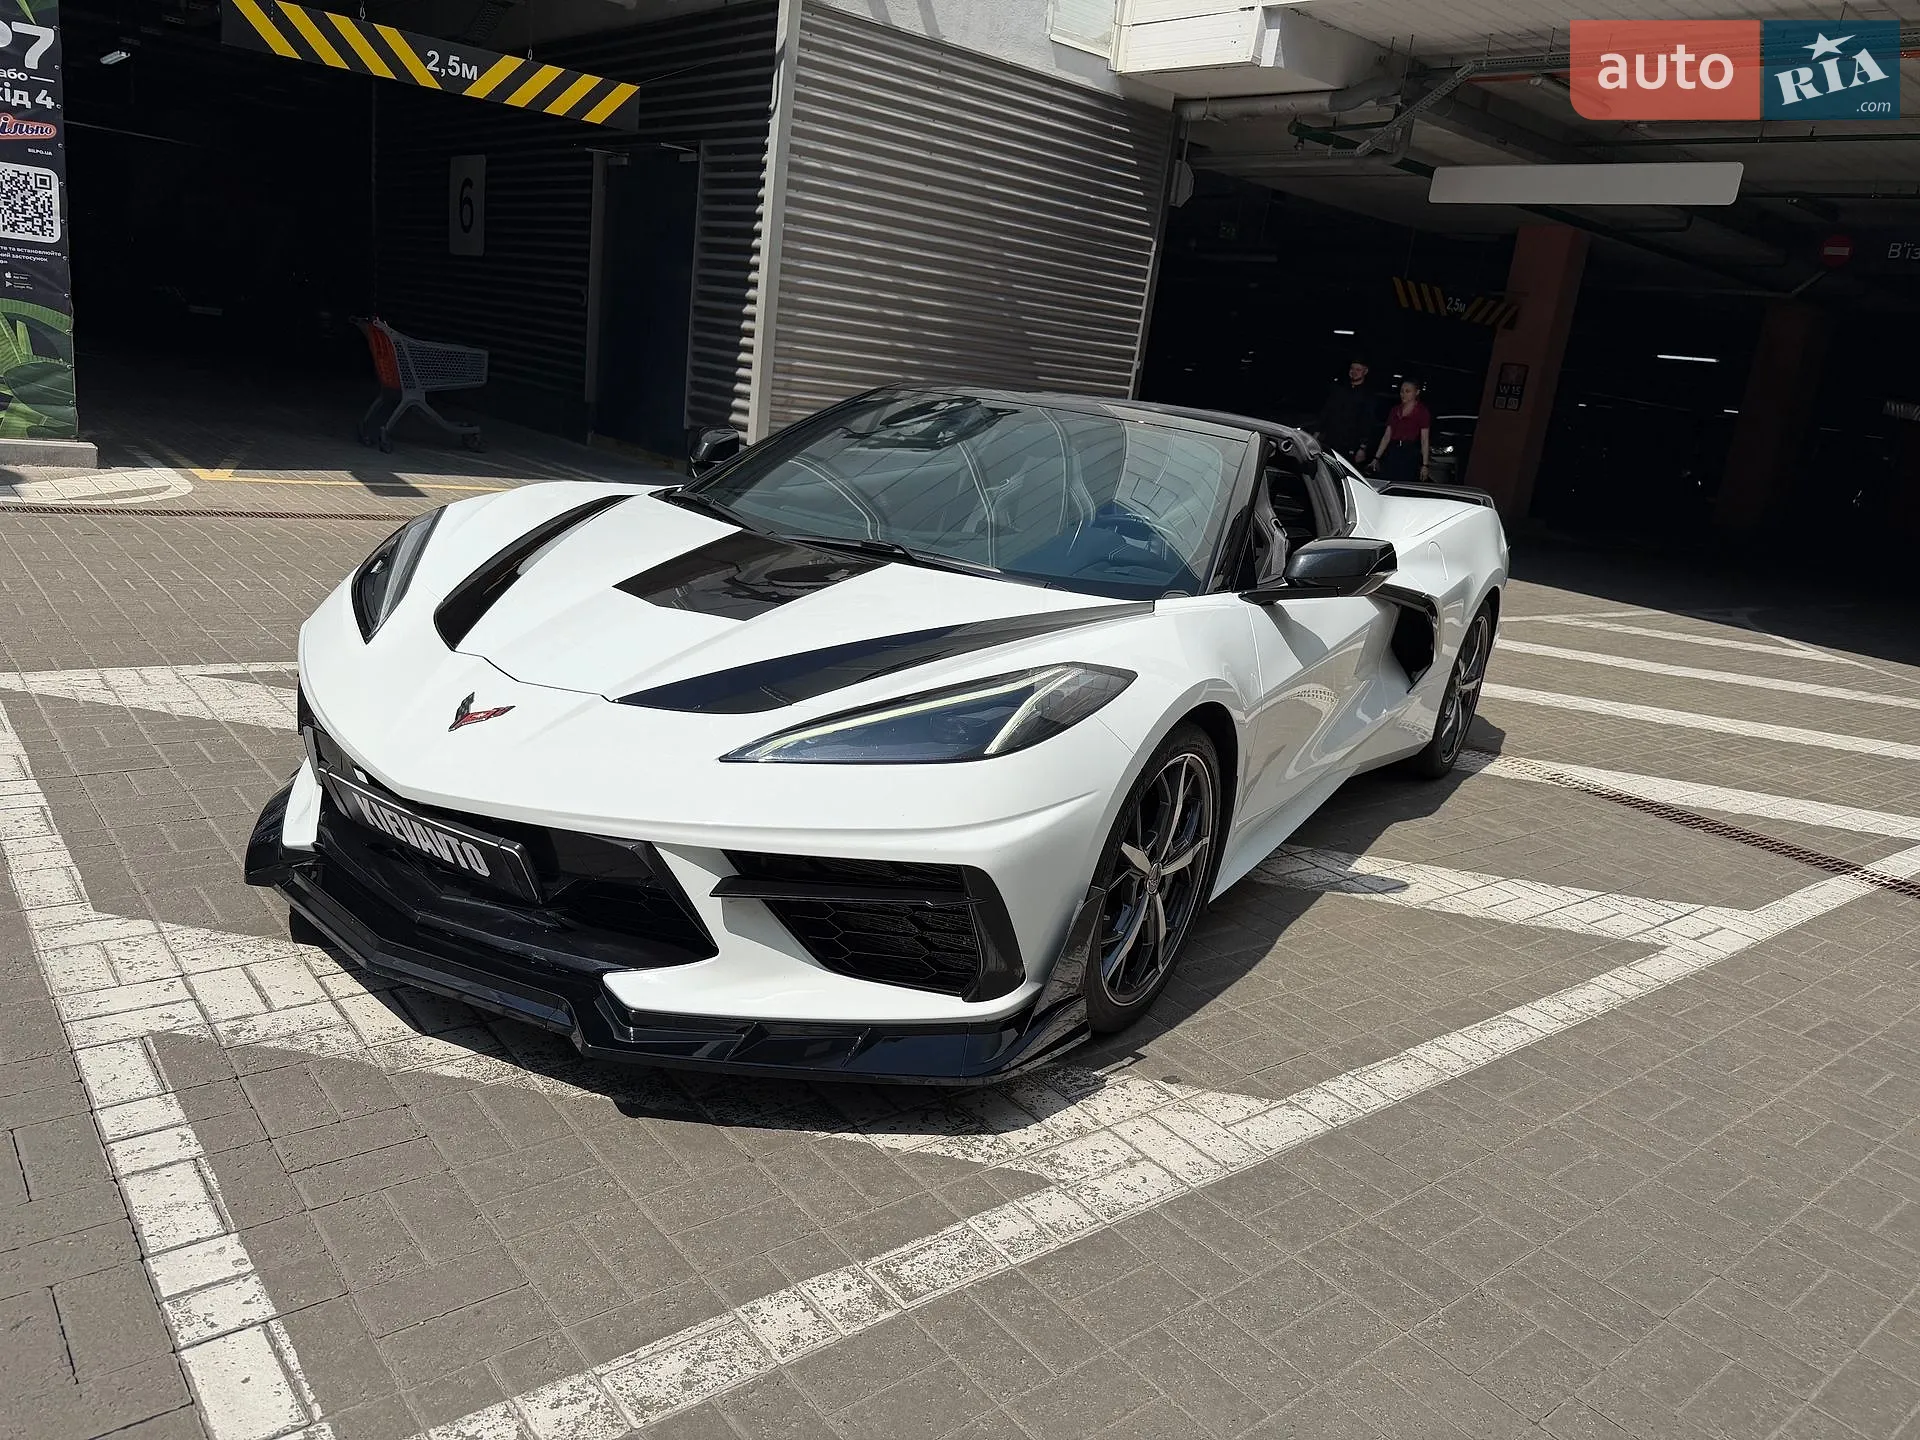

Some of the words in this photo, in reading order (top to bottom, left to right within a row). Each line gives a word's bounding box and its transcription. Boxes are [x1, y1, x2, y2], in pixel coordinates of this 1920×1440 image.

[35, 89, 55, 109] 4
[460, 177, 474, 234] 6
[351, 791, 491, 878] KIEVAVTO
